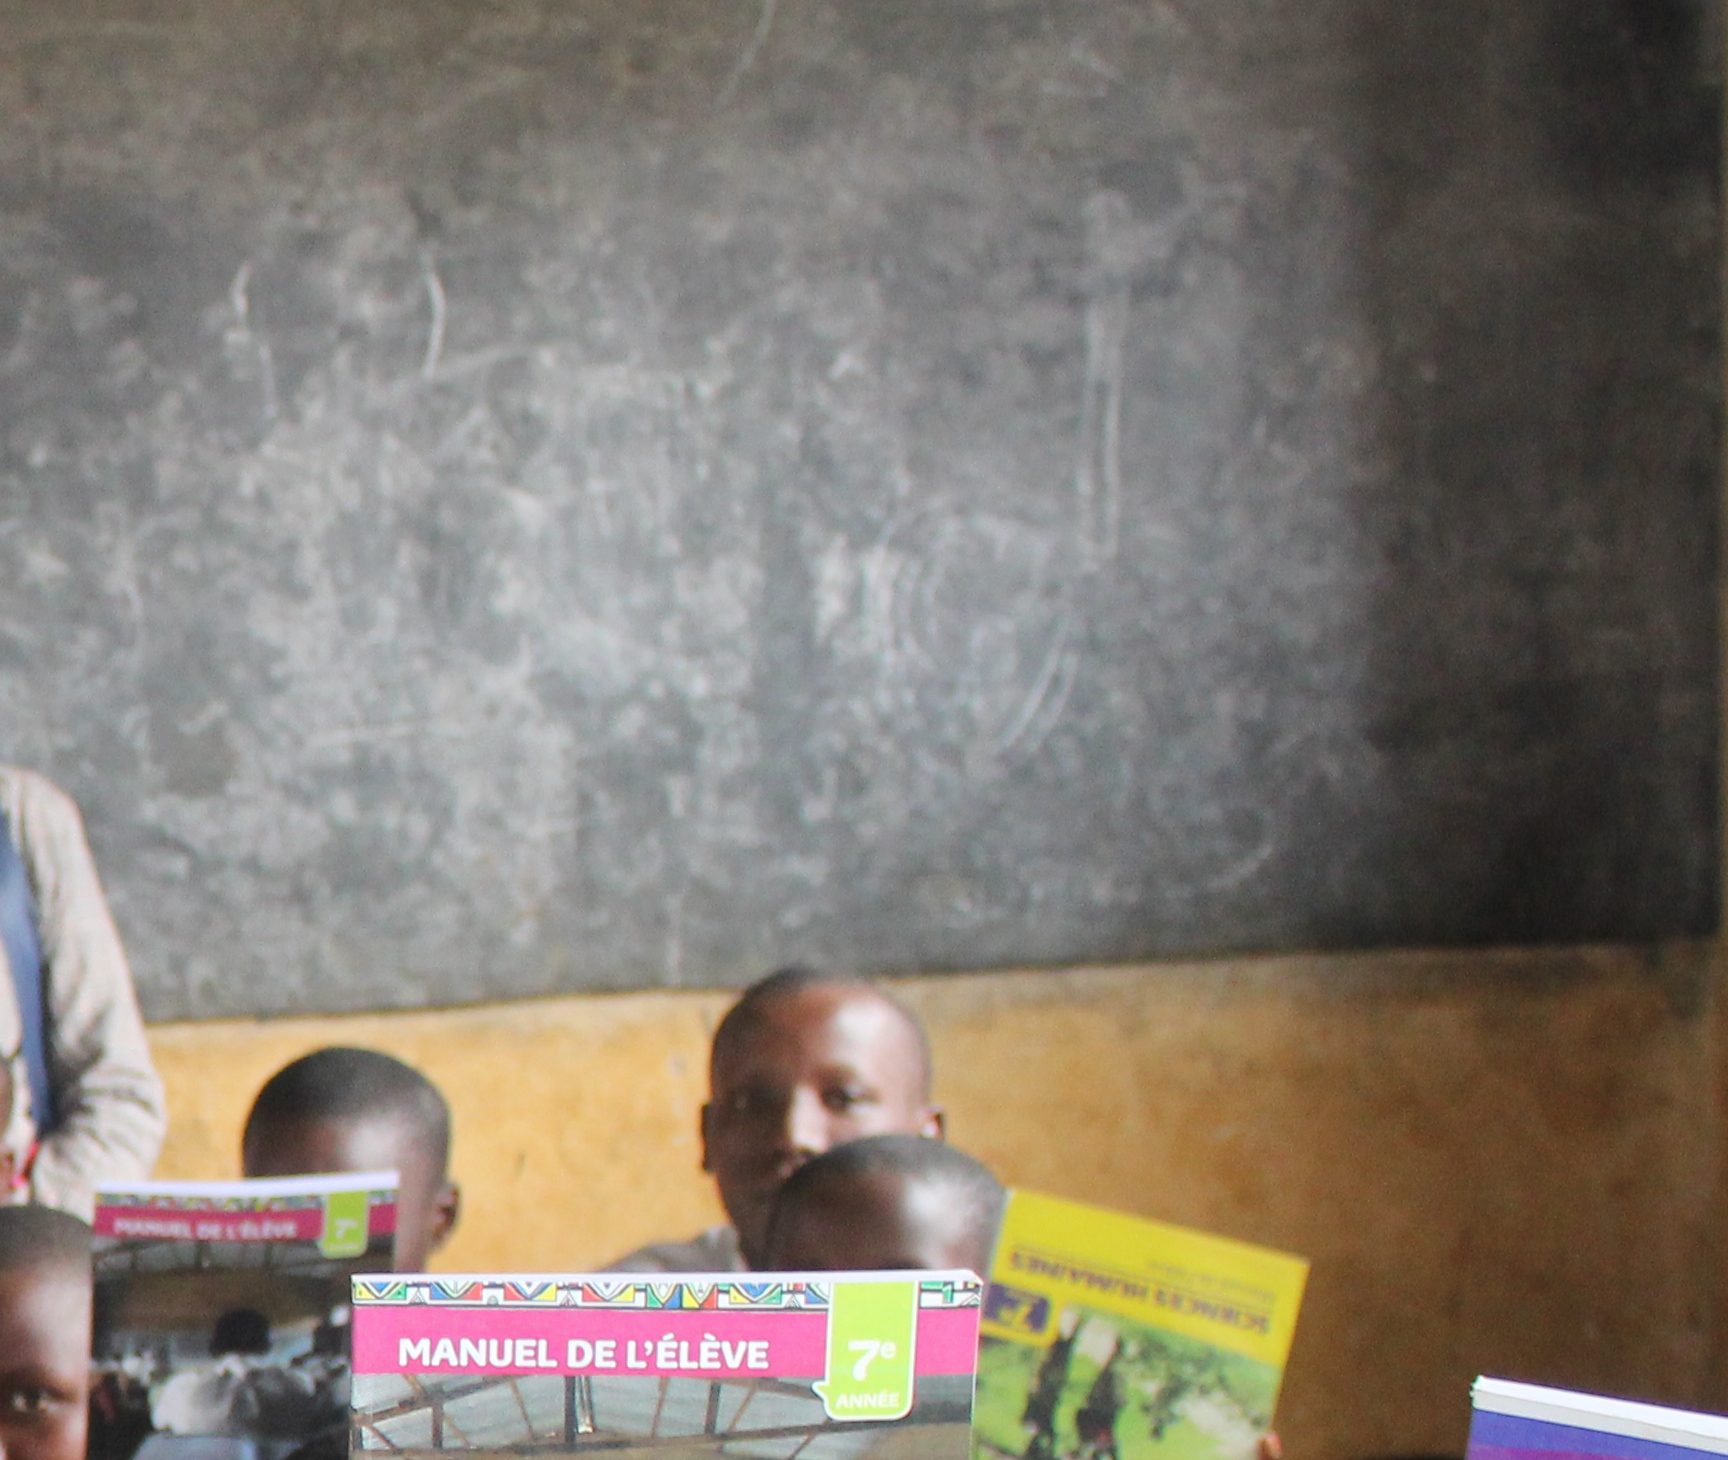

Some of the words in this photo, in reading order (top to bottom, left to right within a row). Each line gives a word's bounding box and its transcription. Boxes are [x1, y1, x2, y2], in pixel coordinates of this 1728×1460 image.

[397, 1337, 558, 1369] MANUEL
[565, 1339, 617, 1370] DE
[625, 1332, 770, 1370] L'ÉLÈVE
[847, 1339, 896, 1383] 7e
[834, 1388, 901, 1409] ANNÉE
